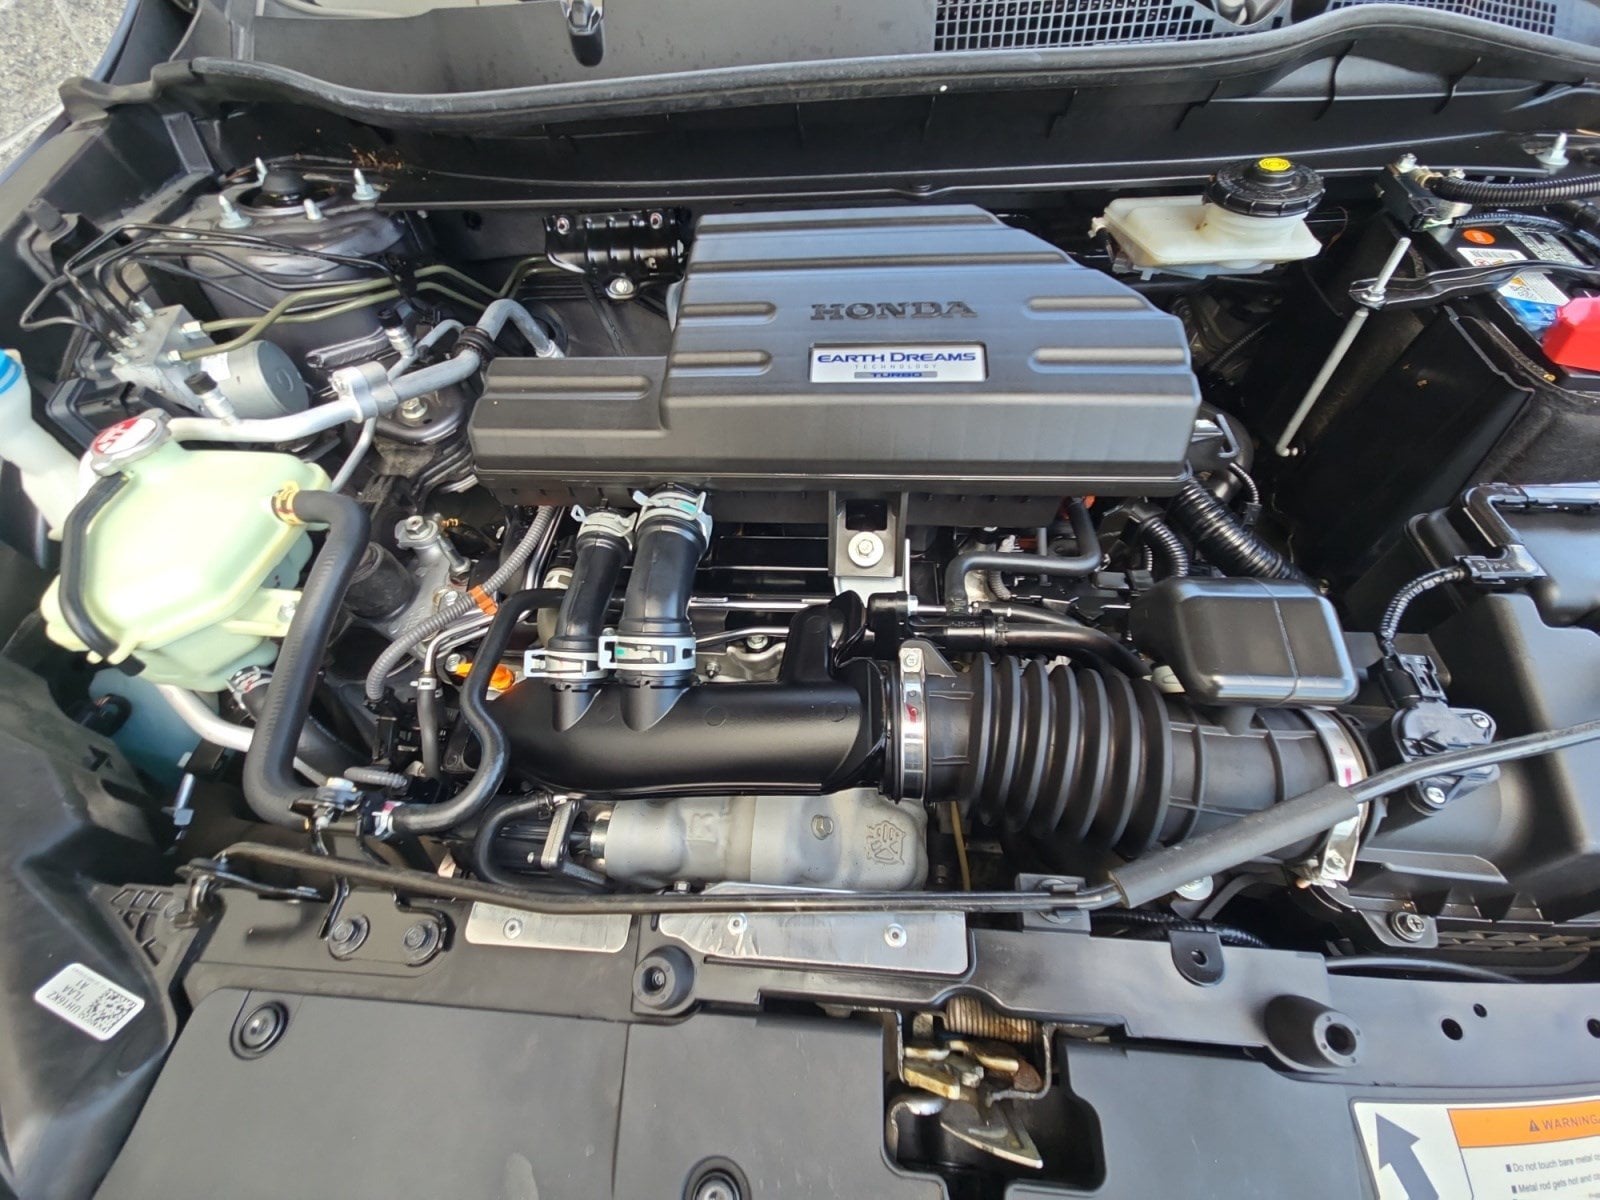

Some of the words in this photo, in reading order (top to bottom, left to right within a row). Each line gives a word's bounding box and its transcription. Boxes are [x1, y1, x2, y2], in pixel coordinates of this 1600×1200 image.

[810, 301, 978, 320] HONDA
[817, 354, 885, 363] EARTH
[890, 352, 977, 363] DREAMS
[1542, 1114, 1600, 1130] WARNING
[1512, 1163, 1524, 1172] Do
[1525, 1162, 1537, 1171] not
[1538, 1160, 1557, 1169] touch
[1518, 1183, 1538, 1192] Metal
[1539, 1181, 1551, 1190] rod
[1552, 1179, 1567, 1190] gets
